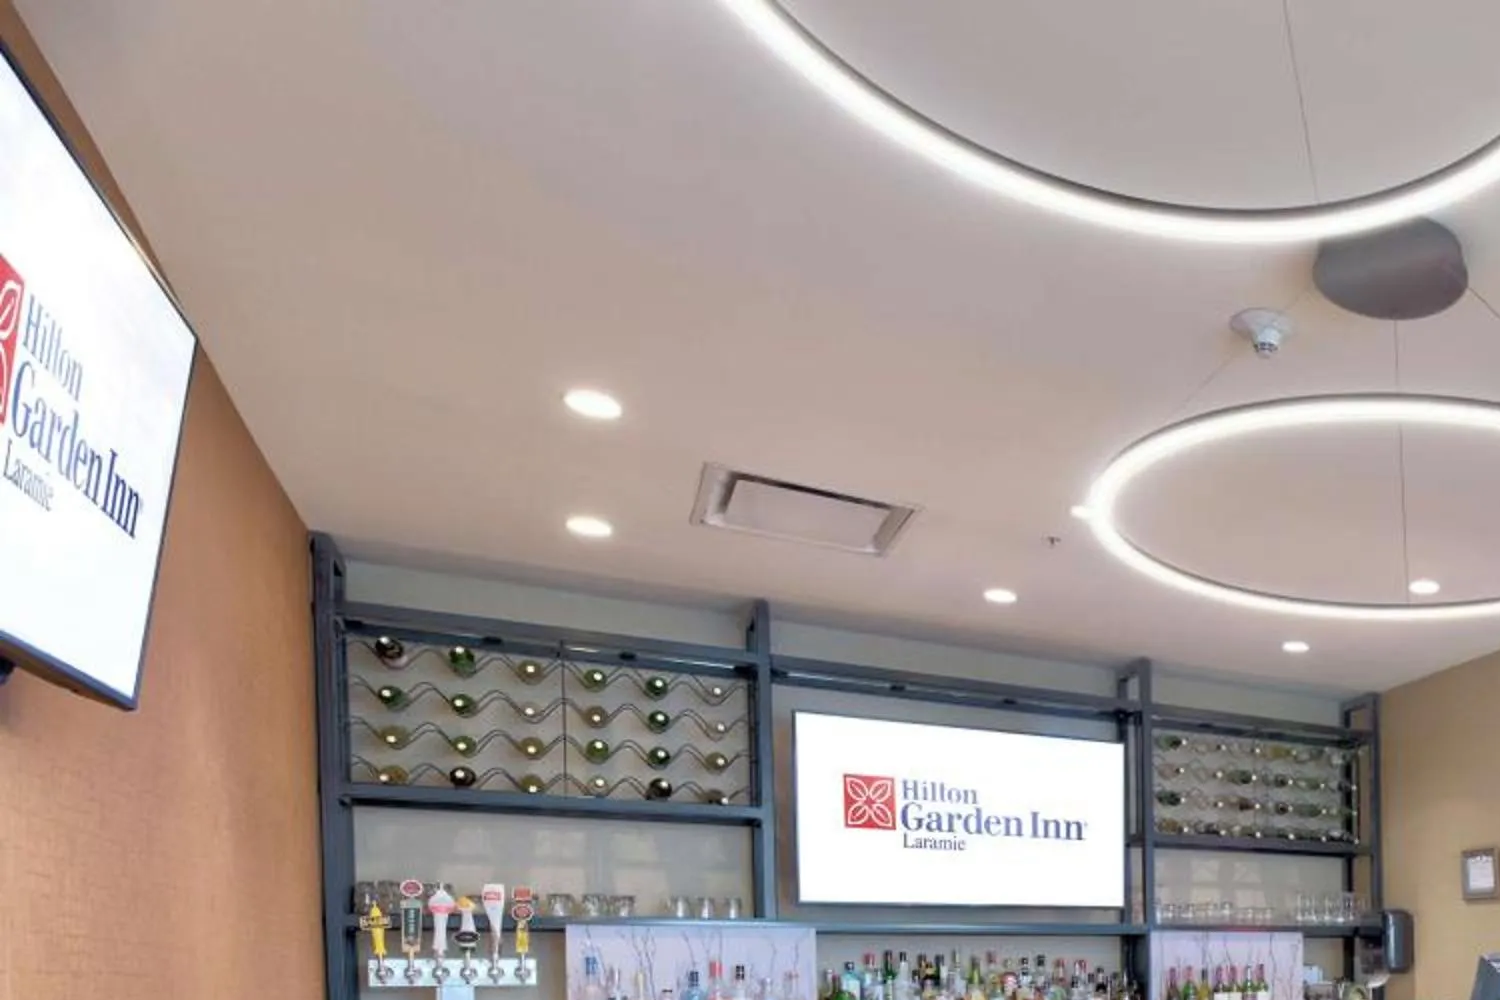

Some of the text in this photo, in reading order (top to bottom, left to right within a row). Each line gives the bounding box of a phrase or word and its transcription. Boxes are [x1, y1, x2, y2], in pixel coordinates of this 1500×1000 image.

[23, 294, 83, 401] Hilton
[12, 360, 140, 538] Garden Inn
[901, 802, 1086, 841] Garden Inn
[902, 779, 978, 805] Hilton
